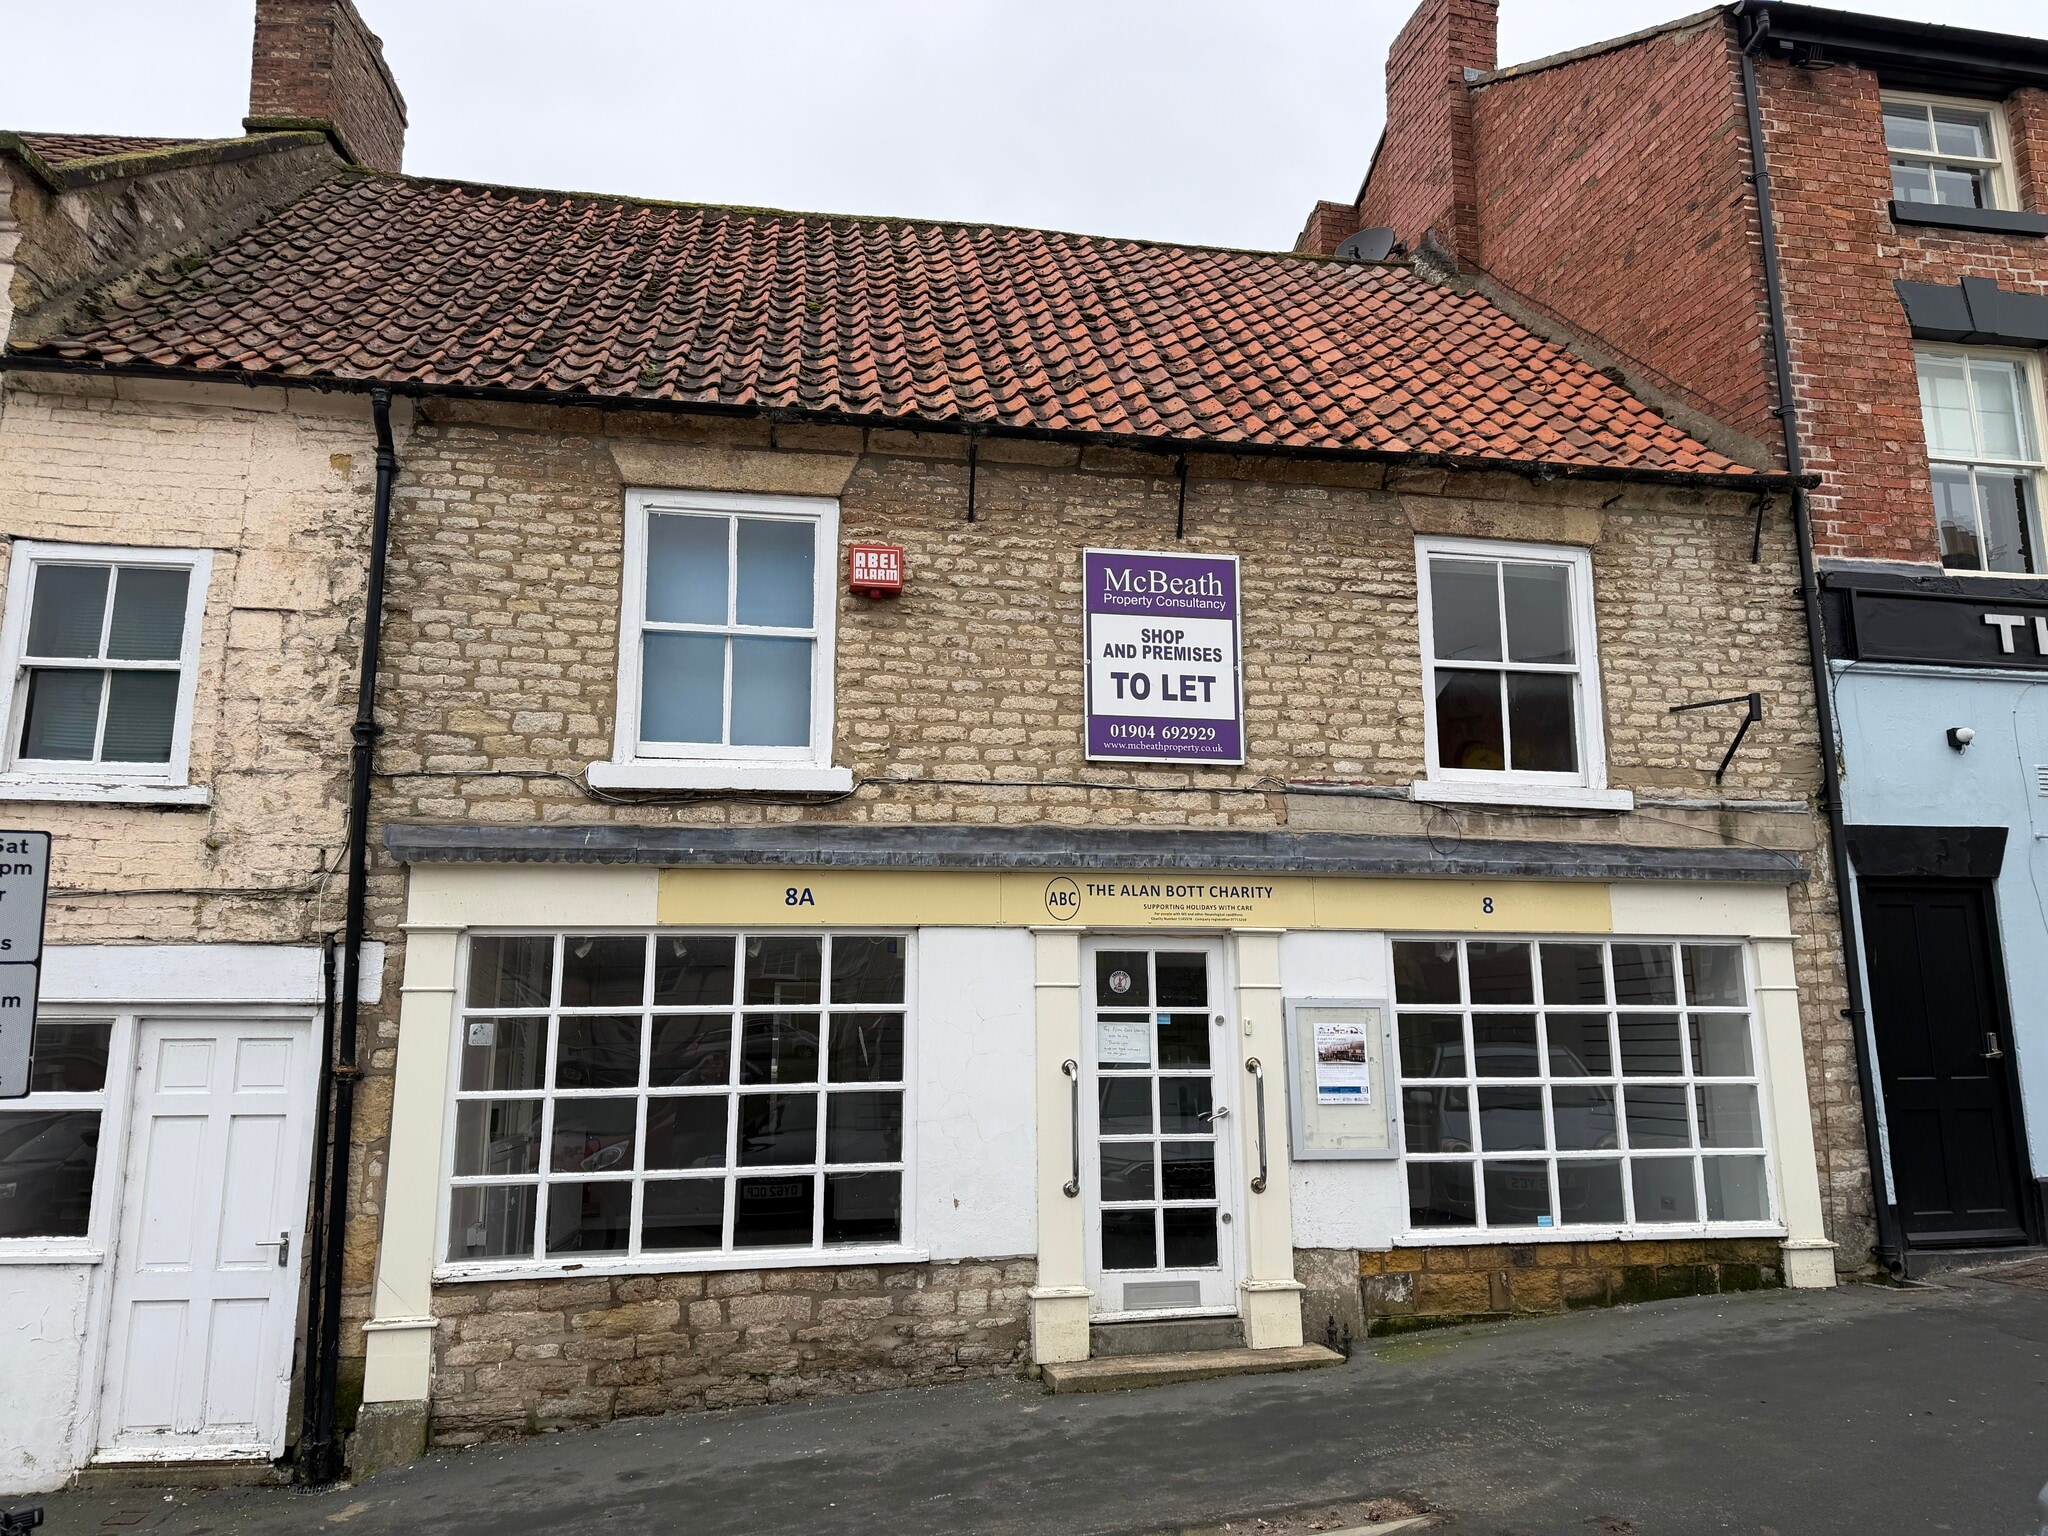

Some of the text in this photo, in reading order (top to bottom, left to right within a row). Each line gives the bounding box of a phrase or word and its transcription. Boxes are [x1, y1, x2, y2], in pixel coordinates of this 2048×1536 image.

[855, 552, 898, 569] ABEL
[855, 568, 898, 581] ALARM
[1103, 567, 1224, 597] McBeath
[1103, 593, 1226, 612] Property Consultancy
[1141, 628, 1185, 645] SHOP
[1103, 643, 1223, 663] AND PREMISES
[1110, 671, 1216, 703] TO LET
[1110, 724, 1216, 741] 01904 692929
[1103, 740, 1224, 754] www.mcbeathproperty.co.uk
[784, 887, 815, 906] 8A
[1048, 891, 1077, 907] ABC
[1086, 884, 1273, 899] THE ALAN BOTT CHARITY
[1482, 896, 1494, 914] 8
